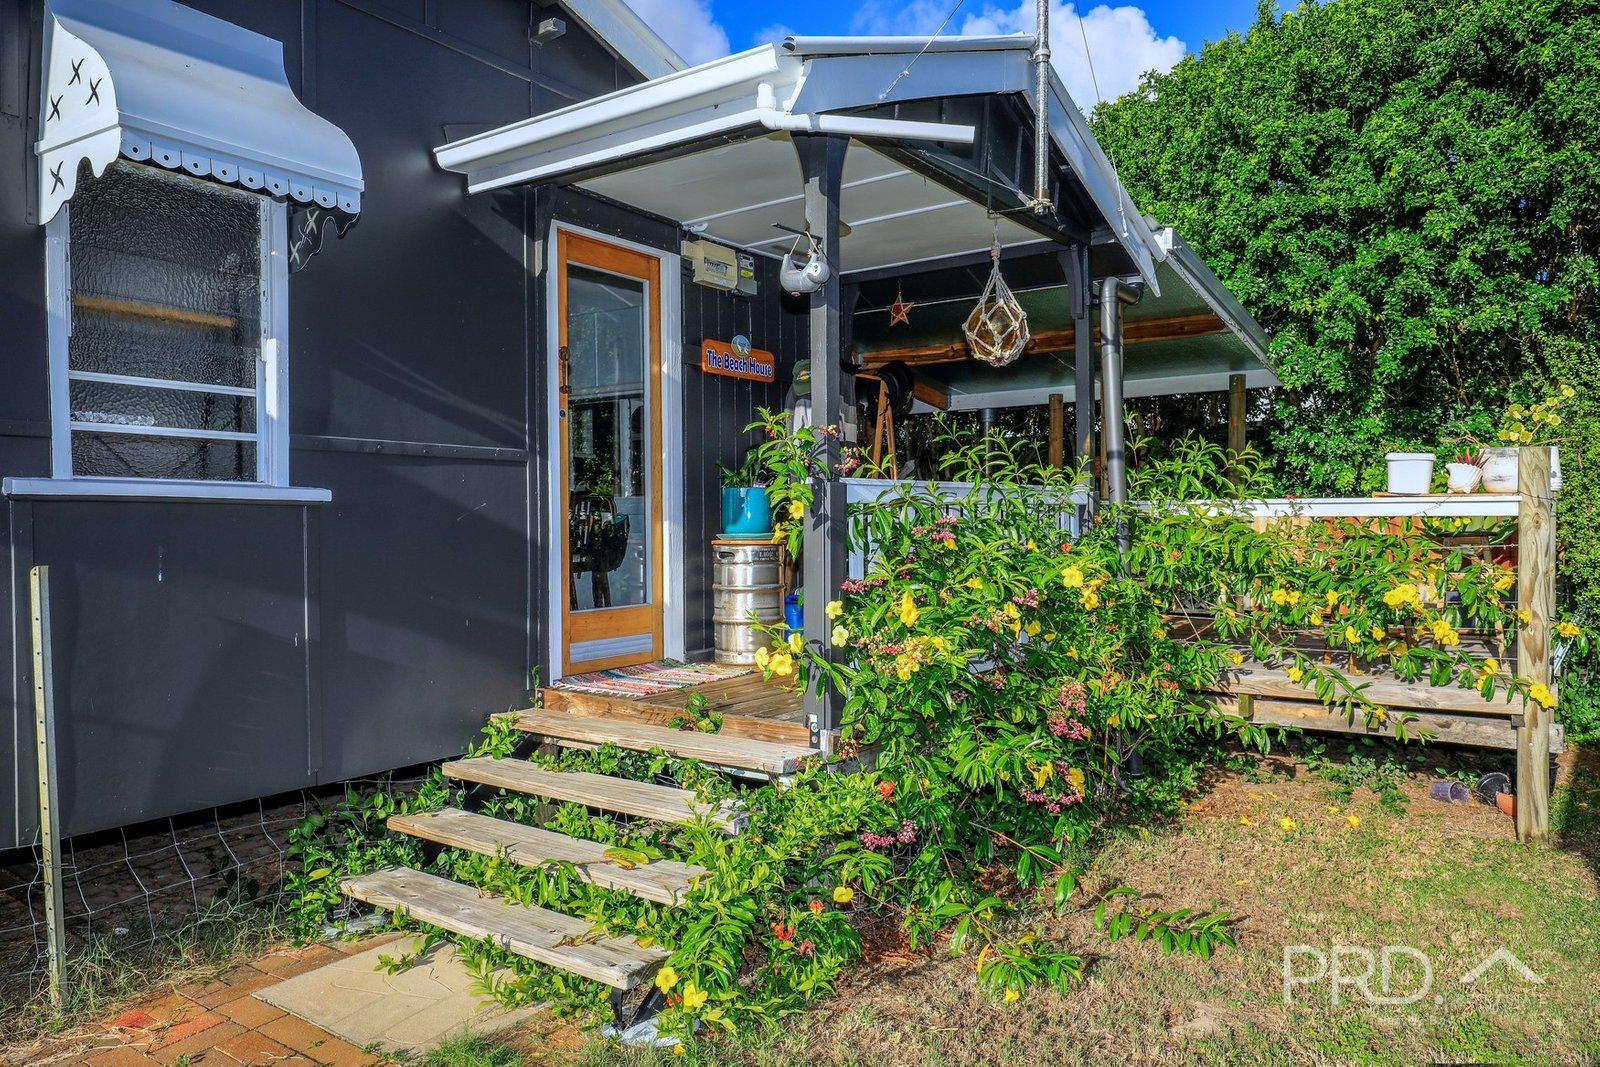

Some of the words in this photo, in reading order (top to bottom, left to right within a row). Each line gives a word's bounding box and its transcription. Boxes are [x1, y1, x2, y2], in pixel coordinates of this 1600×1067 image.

[707, 350, 722, 368] The
[724, 352, 747, 373] Beach
[749, 357, 772, 377] House
